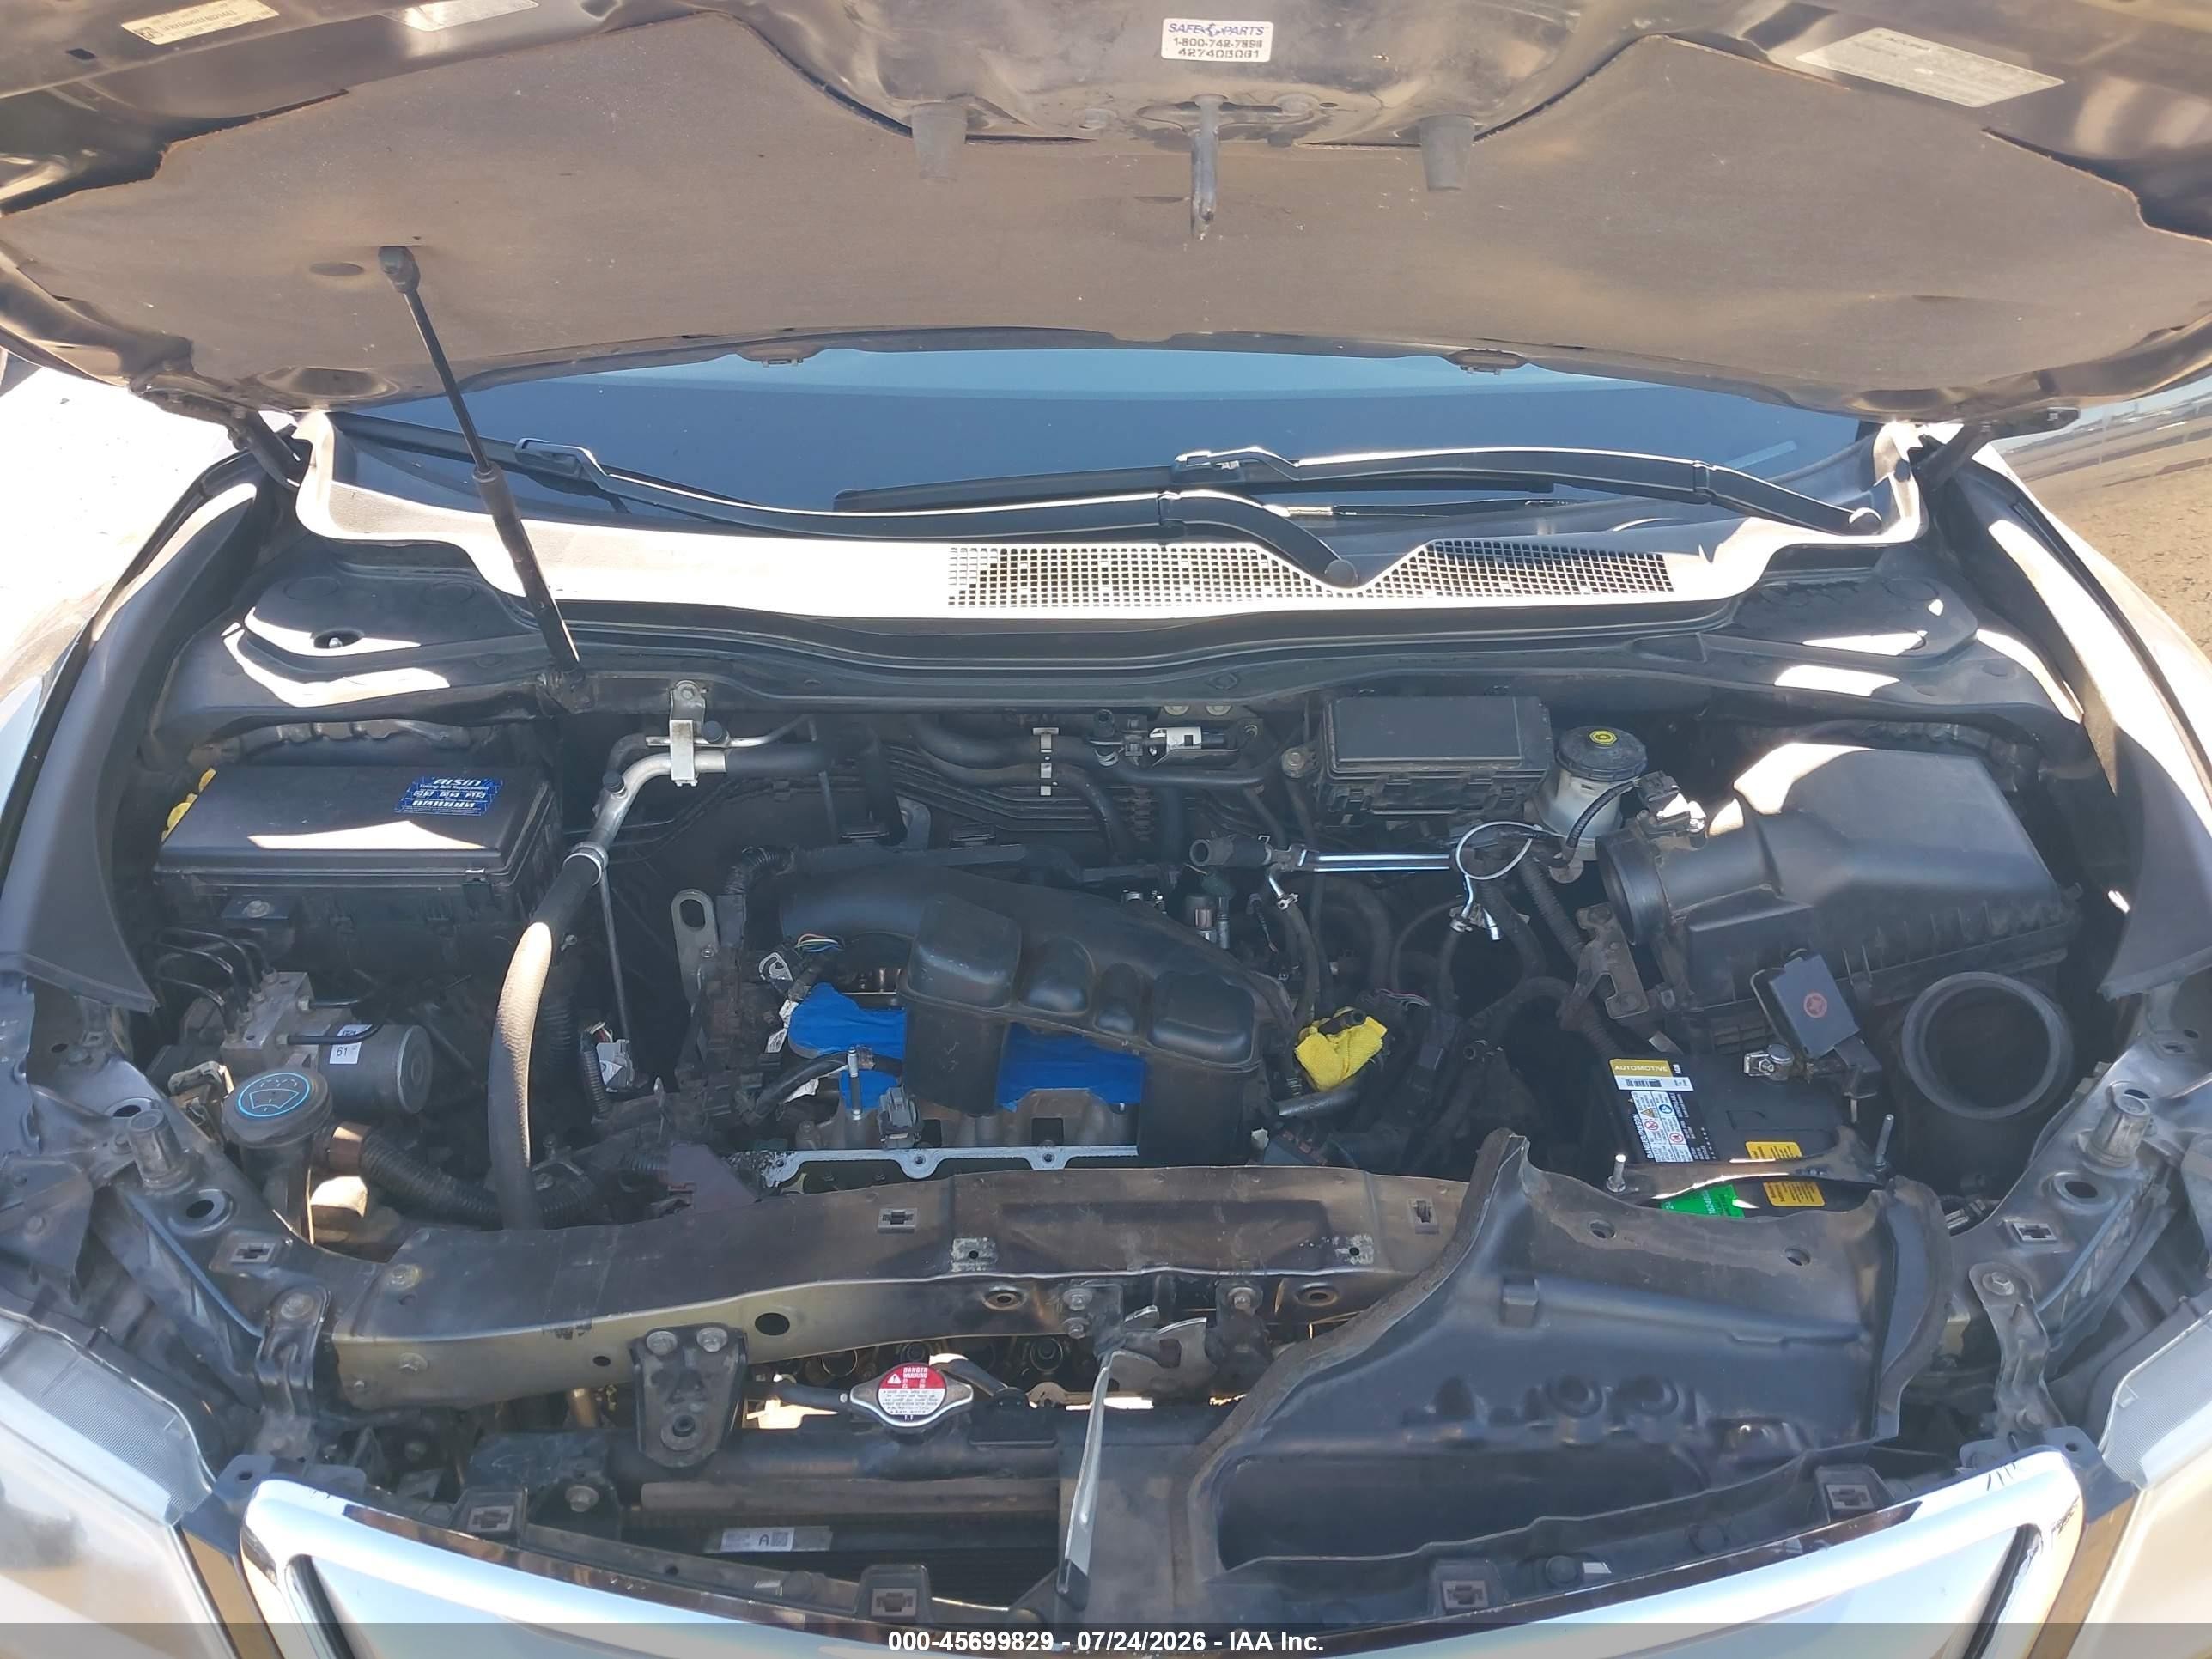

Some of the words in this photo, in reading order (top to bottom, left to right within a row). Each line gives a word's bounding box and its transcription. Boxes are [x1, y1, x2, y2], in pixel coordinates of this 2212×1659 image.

[1168, 23, 1201, 34] SAFE
[1221, 26, 1264, 36] PARTS
[337, 1046, 348, 1057] 61
[1632, 1114, 1654, 1158] DANGER/POISON
[758, 1534, 770, 1546] A
